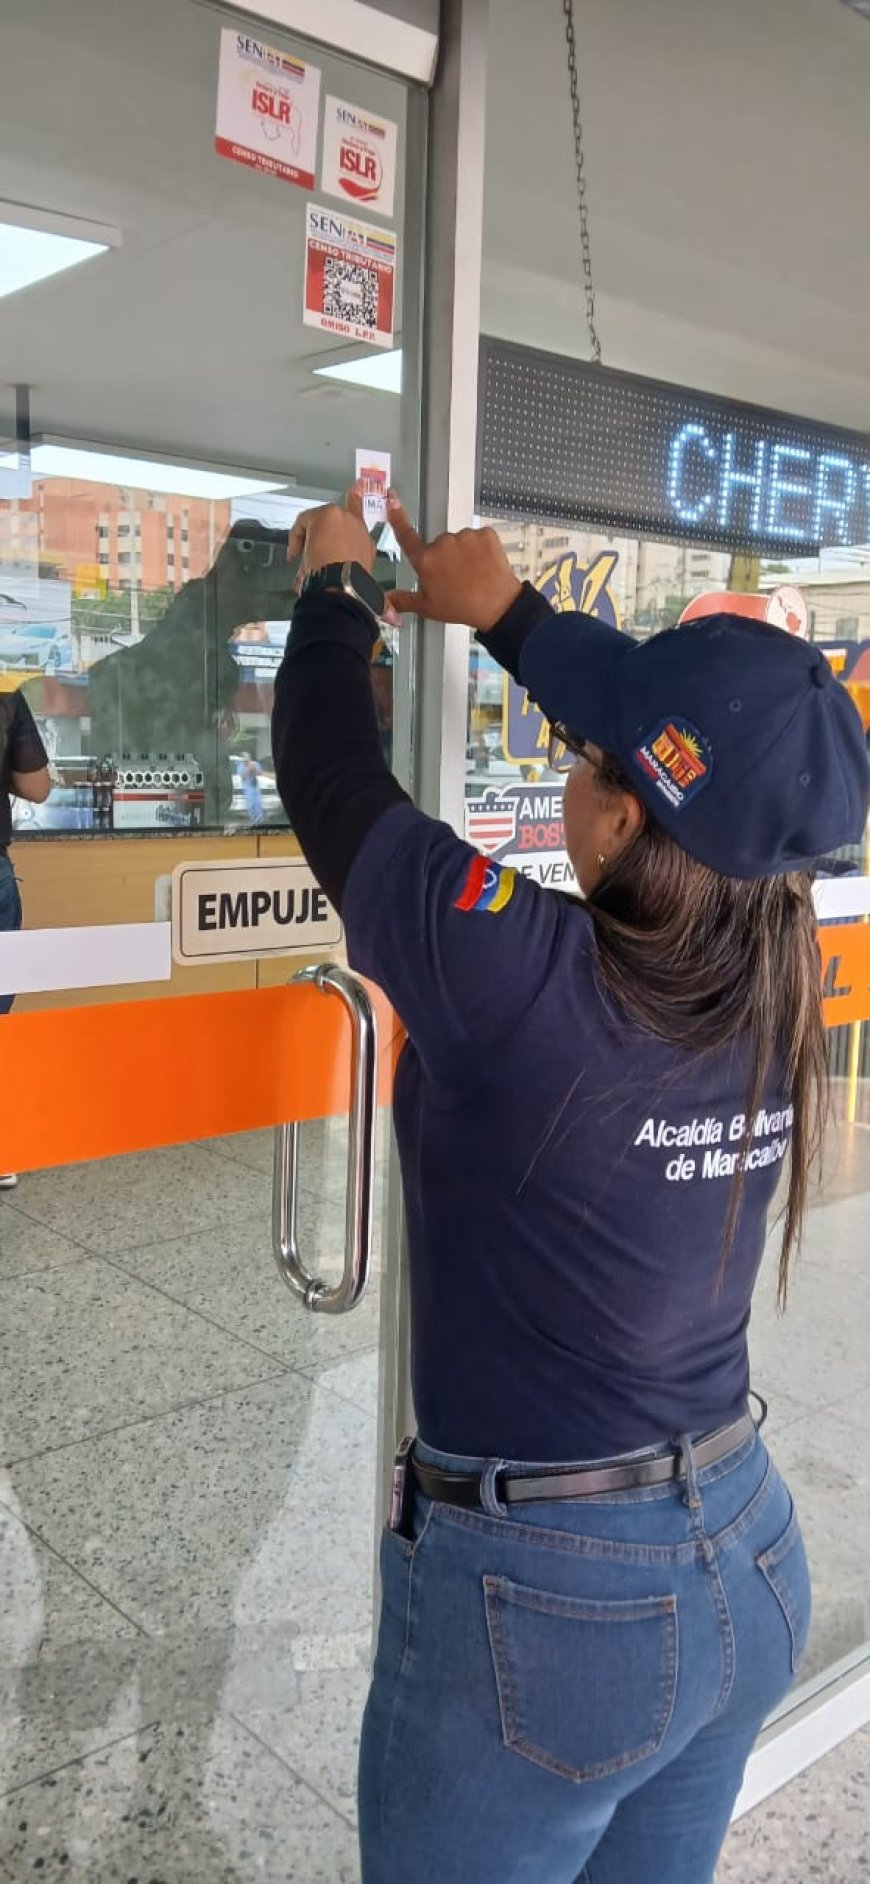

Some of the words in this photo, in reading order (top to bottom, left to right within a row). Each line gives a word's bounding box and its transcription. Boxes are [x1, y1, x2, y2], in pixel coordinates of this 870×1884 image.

[252, 89, 291, 124] ISLR
[340, 146, 376, 180] ISLR
[309, 240, 340, 257] CENSO
[341, 249, 393, 274] TRIBUTARIO
[667, 423, 870, 545] CHER
[518, 822, 565, 849] BOS
[198, 888, 328, 931] EMPUJE
[634, 1117, 723, 1148] Alcaldía
[665, 1153, 696, 1181] de
